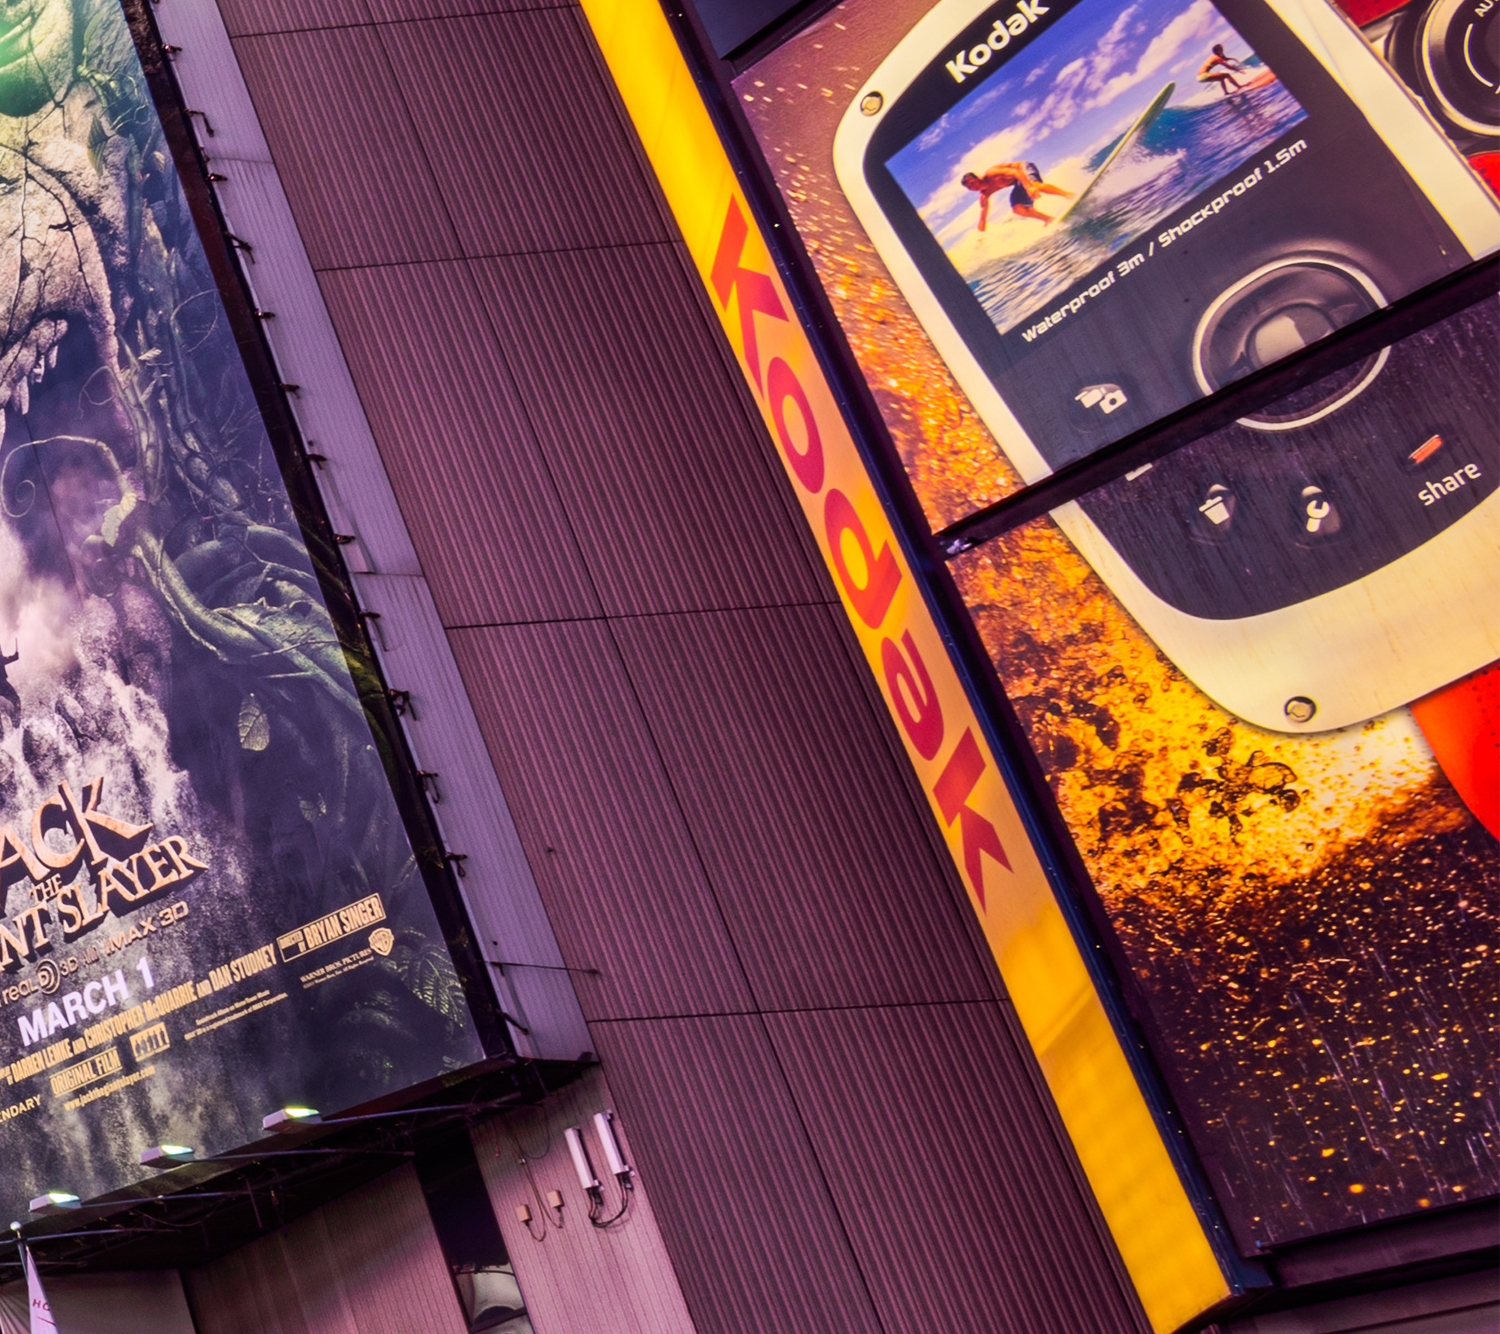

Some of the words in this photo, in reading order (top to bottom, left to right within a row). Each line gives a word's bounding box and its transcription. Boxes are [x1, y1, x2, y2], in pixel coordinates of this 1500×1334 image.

[1019, 268, 1120, 343] Waterproof
[1115, 250, 1146, 282] 3m
[1156, 164, 1262, 249] Shockproof
[1262, 137, 1307, 178] 1.5m
[1416, 460, 1481, 507] share
[711, 192, 1014, 914] Kodak
[29, 873, 62, 904] THE
[56, 835, 209, 935] SLAYER
[103, 917, 157, 955] IMAX
[159, 900, 189, 927] 3D
[17, 969, 129, 1047] MARCH
[136, 956, 155, 989] 1
[84, 1008, 145, 1049] CHRISTOPHER
[209, 968, 234, 992] DAN
[230, 943, 278, 982] STUDNEY
[304, 916, 342, 949] BRYAN
[339, 896, 384, 933] SINGER
[50, 1058, 97, 1096] ORIGINAL
[98, 1049, 122, 1073] FILM
